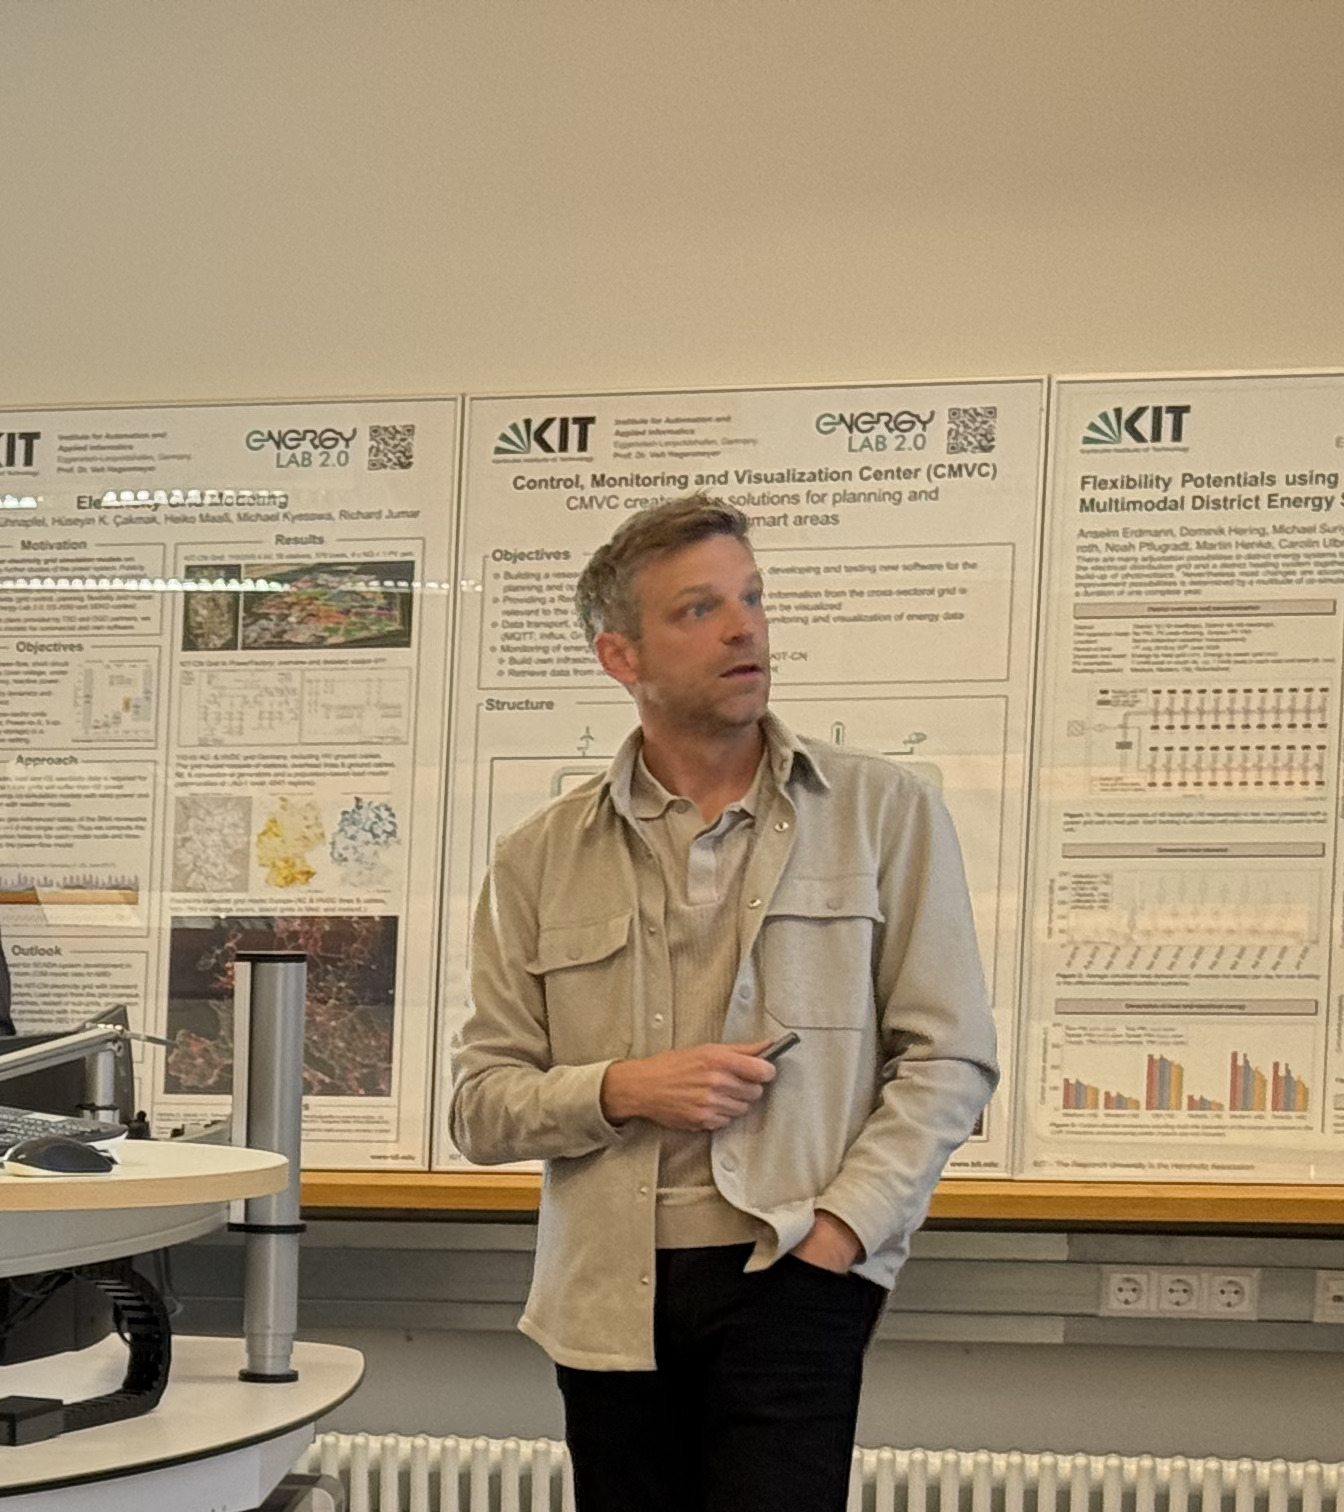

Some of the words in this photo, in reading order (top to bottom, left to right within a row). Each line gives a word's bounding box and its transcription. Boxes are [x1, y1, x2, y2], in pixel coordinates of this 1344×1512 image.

[1113, 405, 1191, 443] KIT
[523, 416, 596, 453] KIT
[848, 435, 887, 452] LAB
[894, 434, 927, 451] 2.0
[276, 452, 312, 468] LAB
[319, 451, 349, 467] 2.0
[512, 474, 585, 491] Control,
[590, 472, 689, 490] Monitoring
[694, 470, 729, 486] and
[735, 467, 852, 485] Visualization
[859, 465, 921, 481] Center
[926, 463, 997, 482] (CMVC)
[1081, 473, 1172, 493] Flexibility
[1181, 471, 1276, 489] Potentials
[1285, 470, 1339, 489] using
[566, 495, 620, 511] CMVC
[728, 490, 800, 506] solutions
[806, 489, 827, 505] for
[832, 487, 902, 507] planning
[907, 486, 939, 501] and
[1079, 495, 1185, 513] Multimodal
[1191, 493, 1260, 511] District
[1267, 492, 1335, 512] Energy
[793, 513, 840, 527] areas
[20, 539, 87, 551] Motivation
[275, 534, 325, 545] Results
[491, 549, 571, 564] Objectives
[823, 565, 842, 573] and
[15, 641, 84, 654] Objectives
[485, 698, 555, 711] Structure
[15, 754, 79, 768] Approach
[11, 944, 62, 957] Outlook
